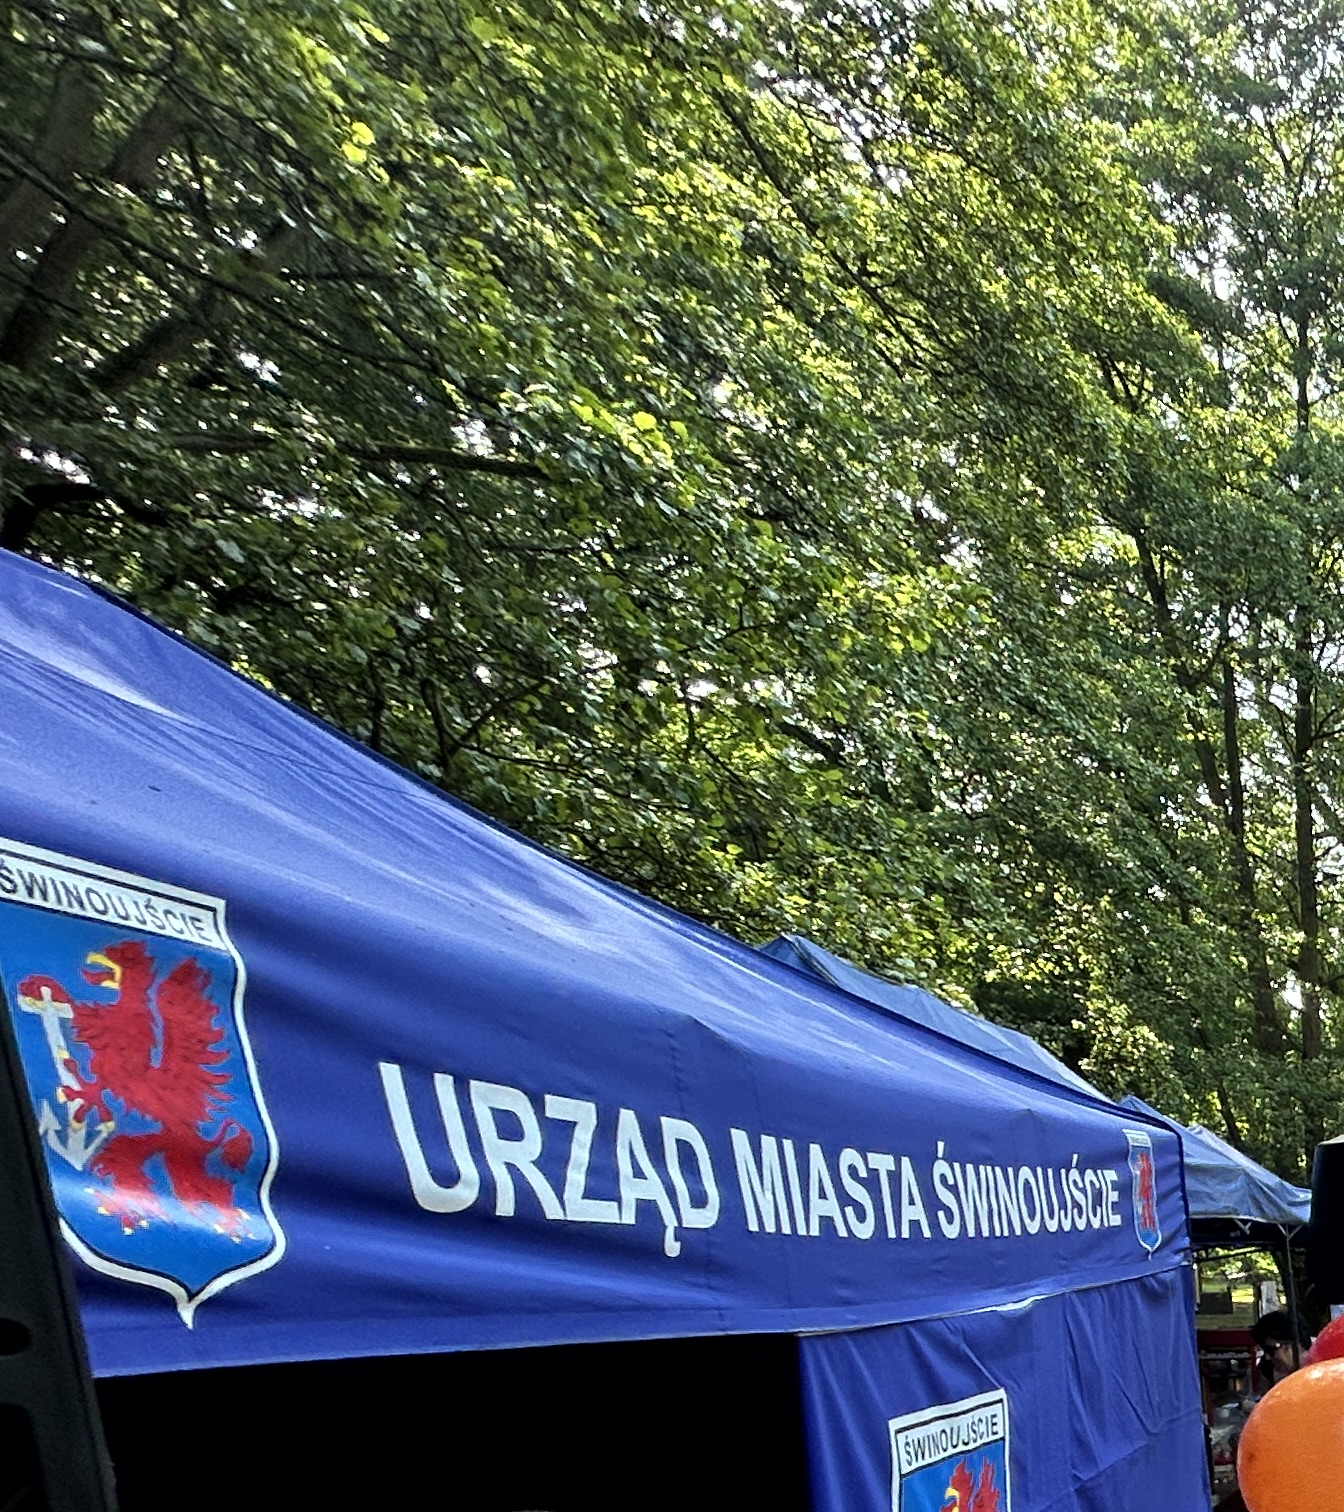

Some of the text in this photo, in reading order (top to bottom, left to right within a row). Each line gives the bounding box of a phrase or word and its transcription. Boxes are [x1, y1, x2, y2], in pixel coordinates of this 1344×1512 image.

[0, 858, 212, 943] ŚWINOUJŚCIE
[378, 1061, 1122, 1258] URZĄD MIASTA ŚWINOUJŚCIE
[903, 1413, 999, 1466] ŚWINOUJŚCIE
